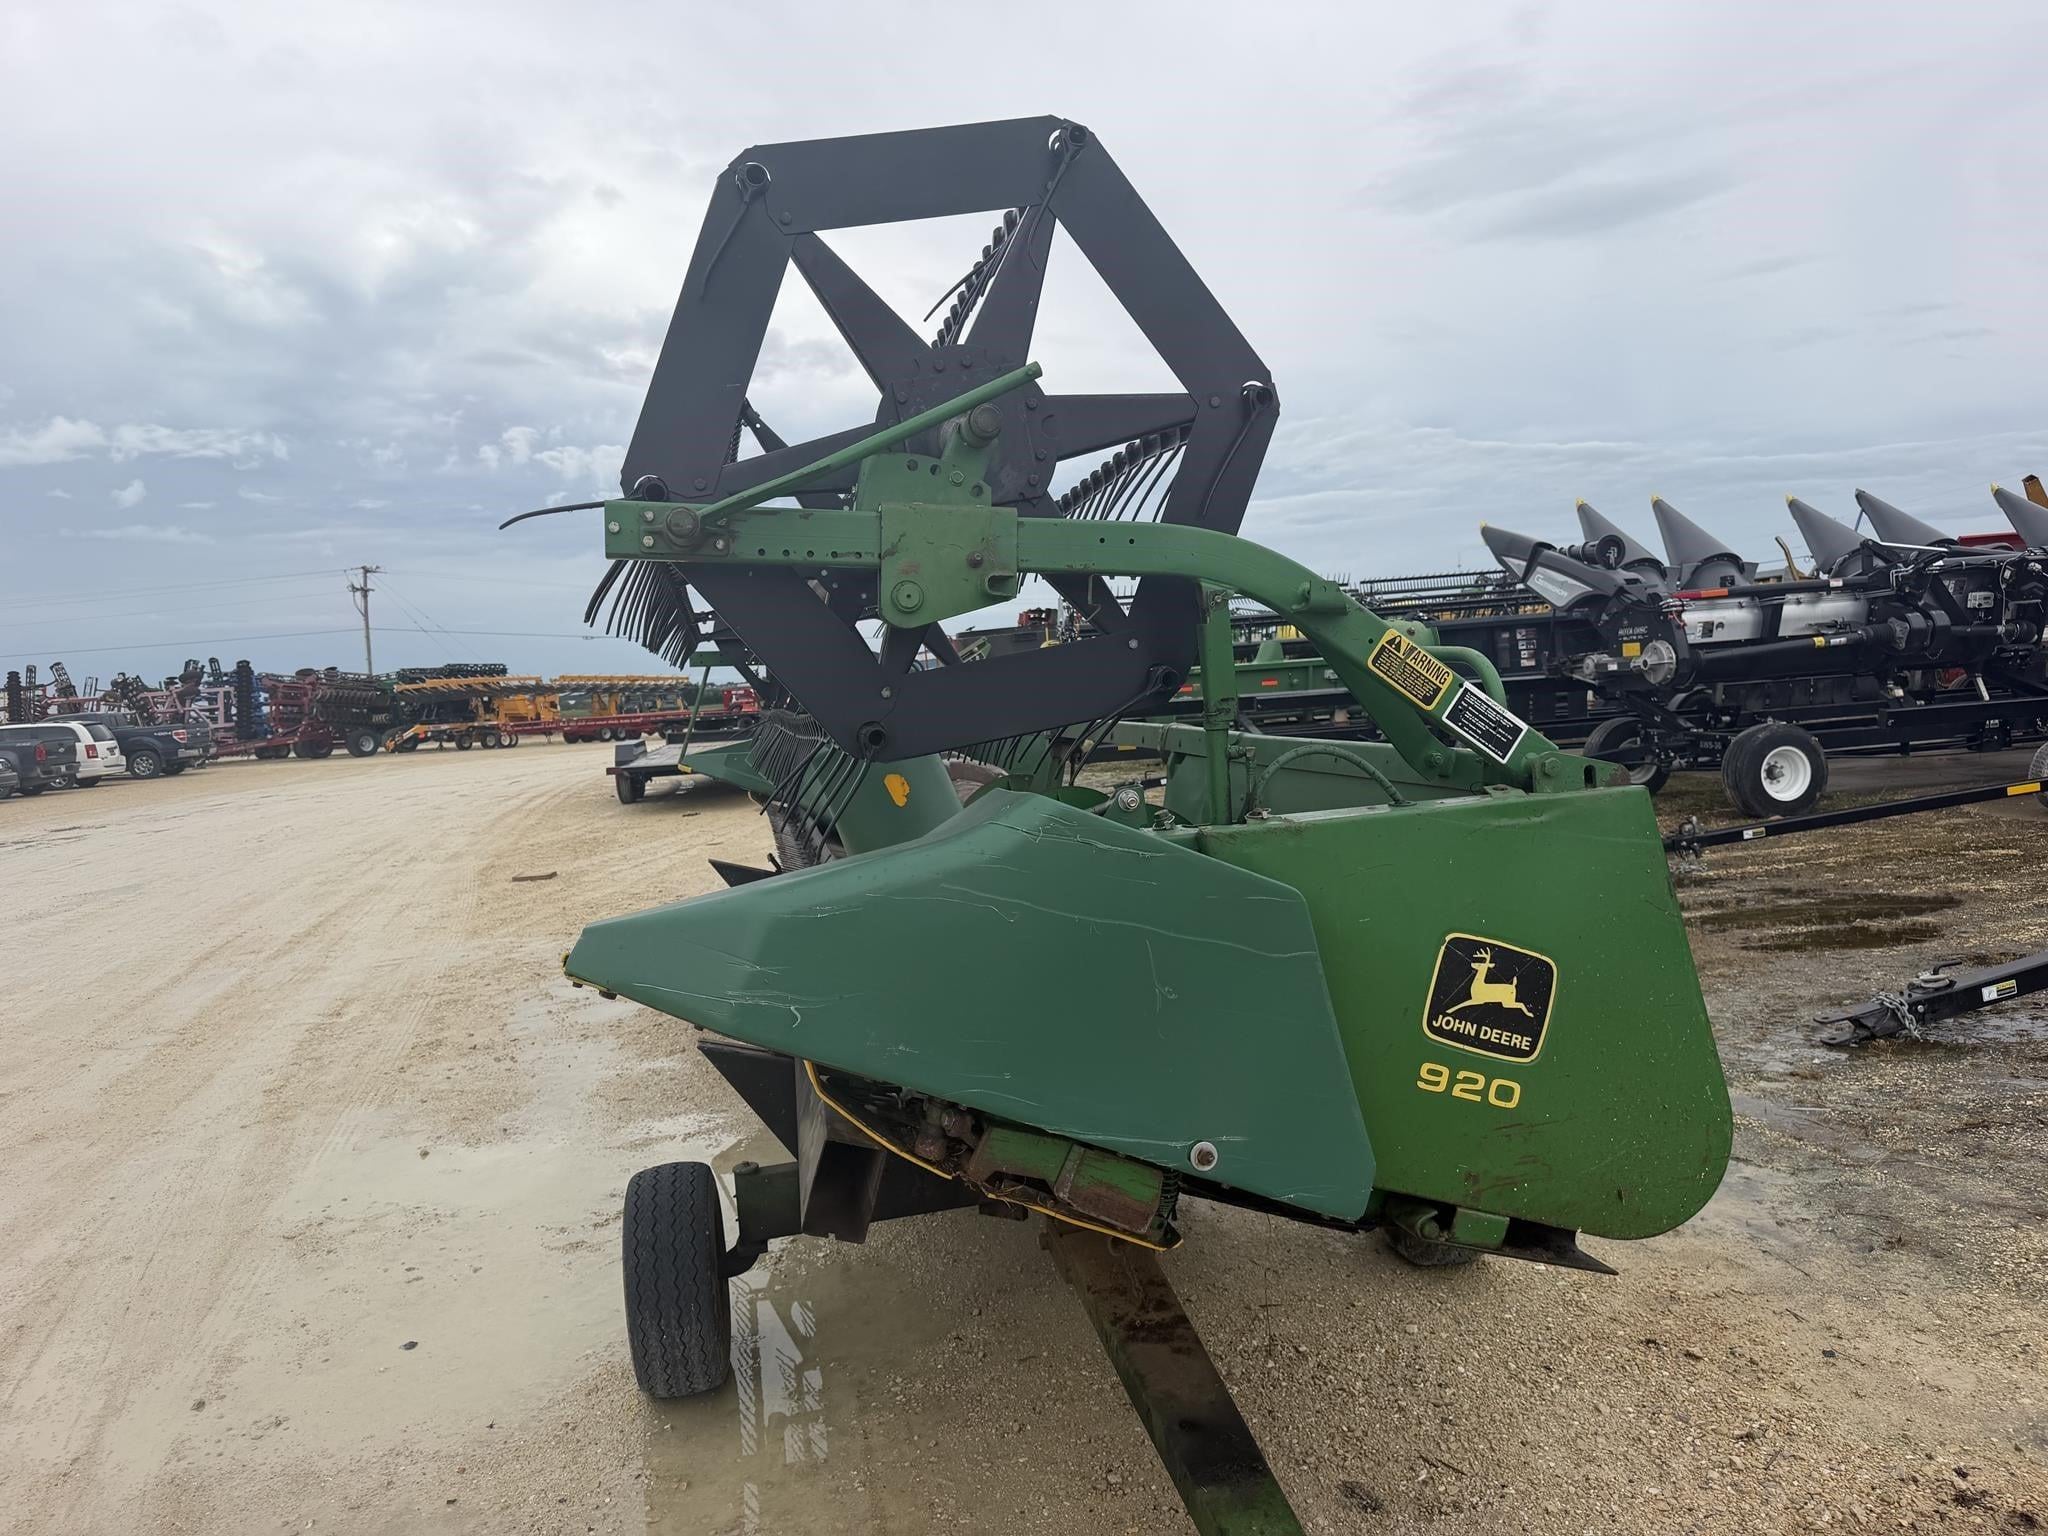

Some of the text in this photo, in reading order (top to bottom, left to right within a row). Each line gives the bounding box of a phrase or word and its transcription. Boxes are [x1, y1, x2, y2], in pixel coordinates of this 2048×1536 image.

[1402, 642, 1450, 685] WARNING
[1432, 1014, 1533, 1051] JOHN DEERE
[1417, 1062, 1522, 1109] 920
